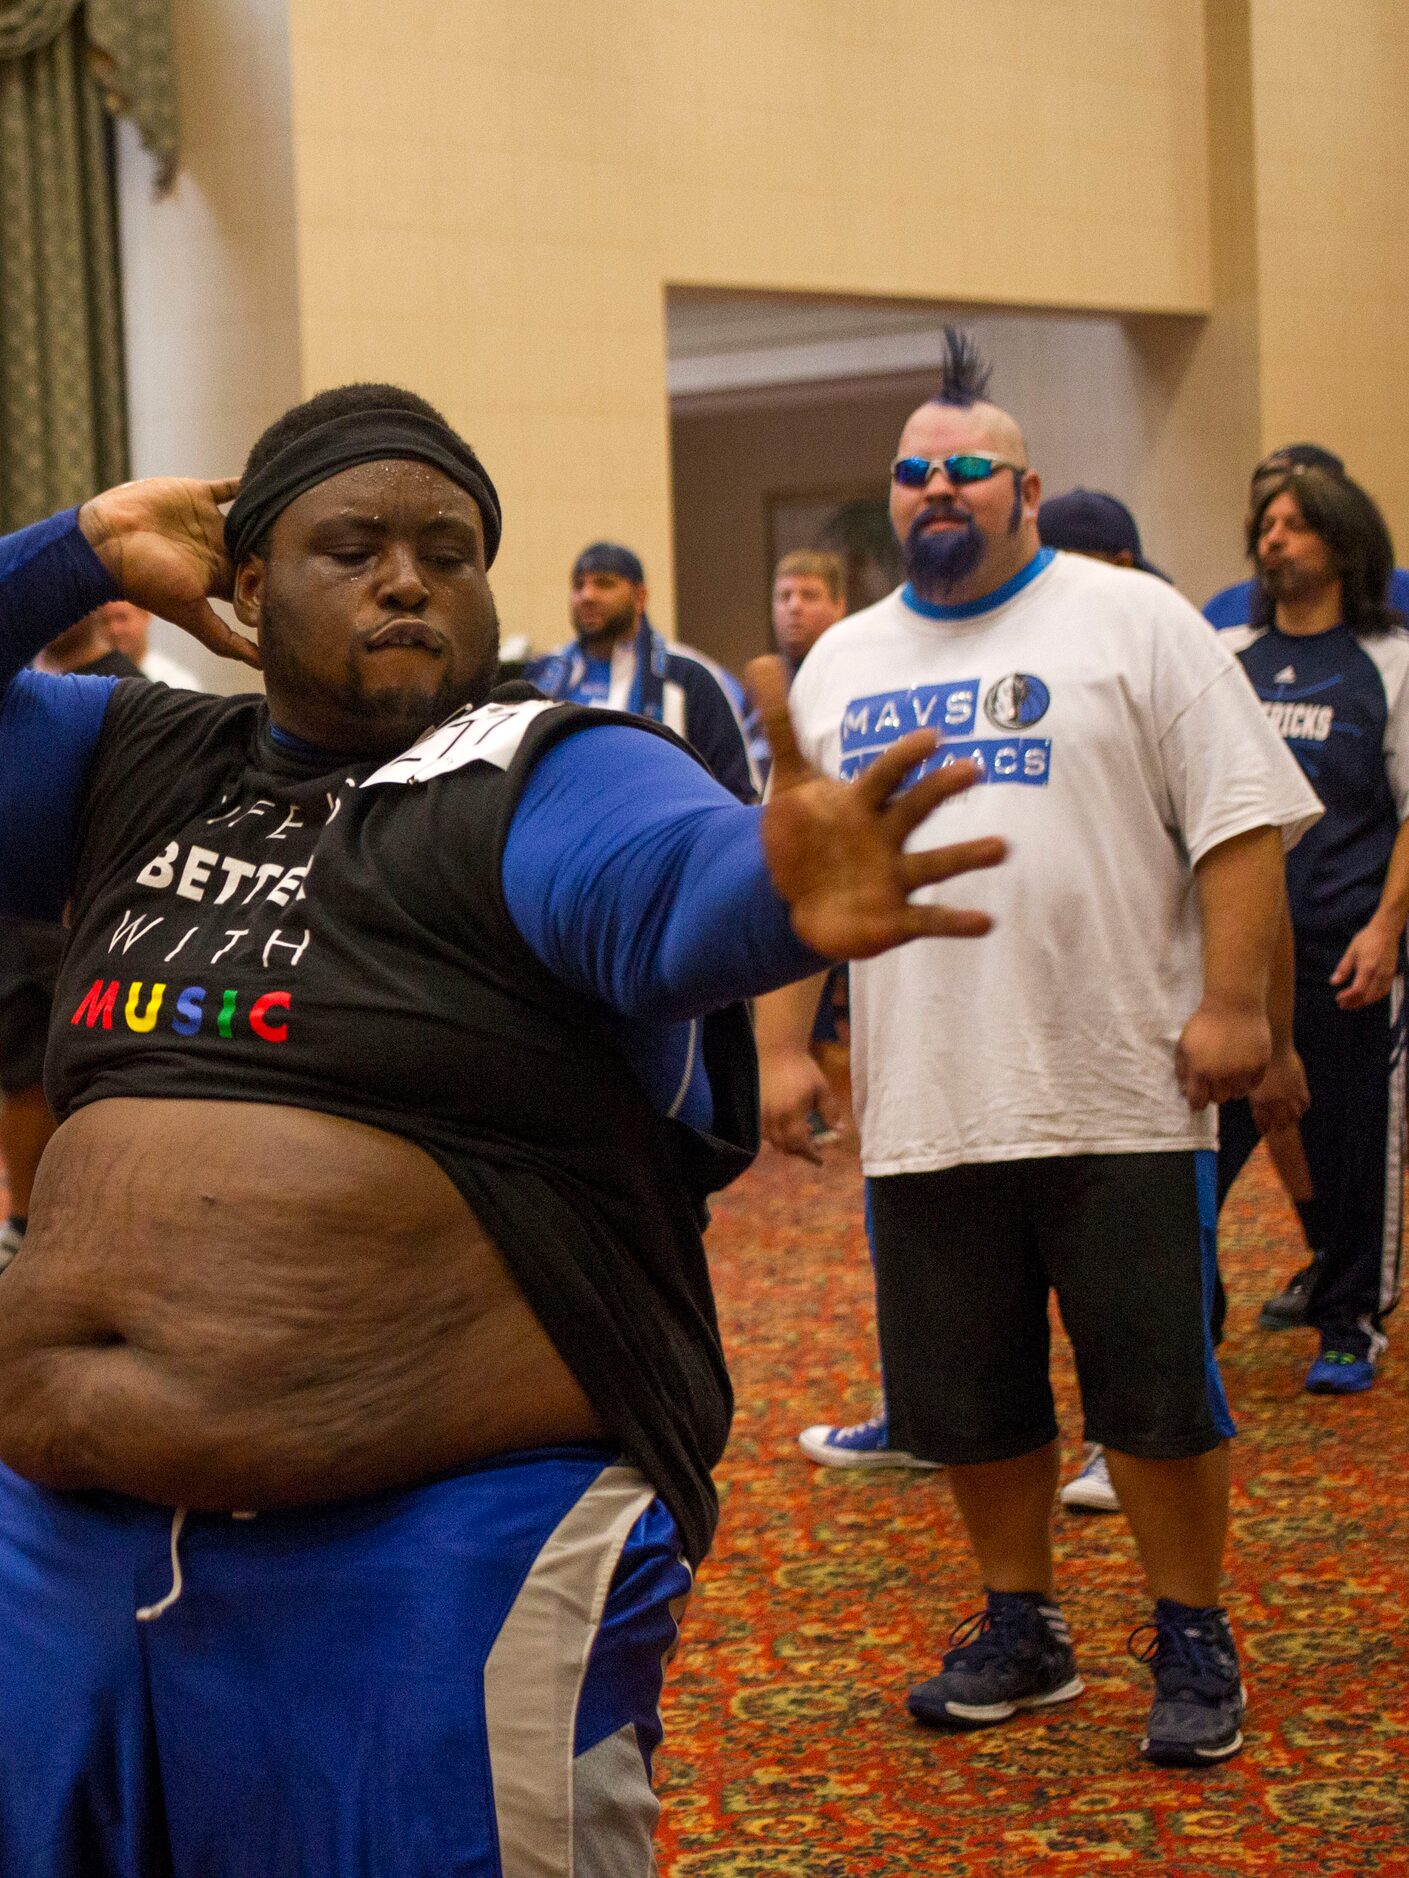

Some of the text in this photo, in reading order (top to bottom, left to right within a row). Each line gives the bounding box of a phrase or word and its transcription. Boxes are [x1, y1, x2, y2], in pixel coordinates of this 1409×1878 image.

[843, 690, 974, 740] MAVS
[107, 910, 310, 967] WITH
[70, 979, 292, 1043] MUSIC
